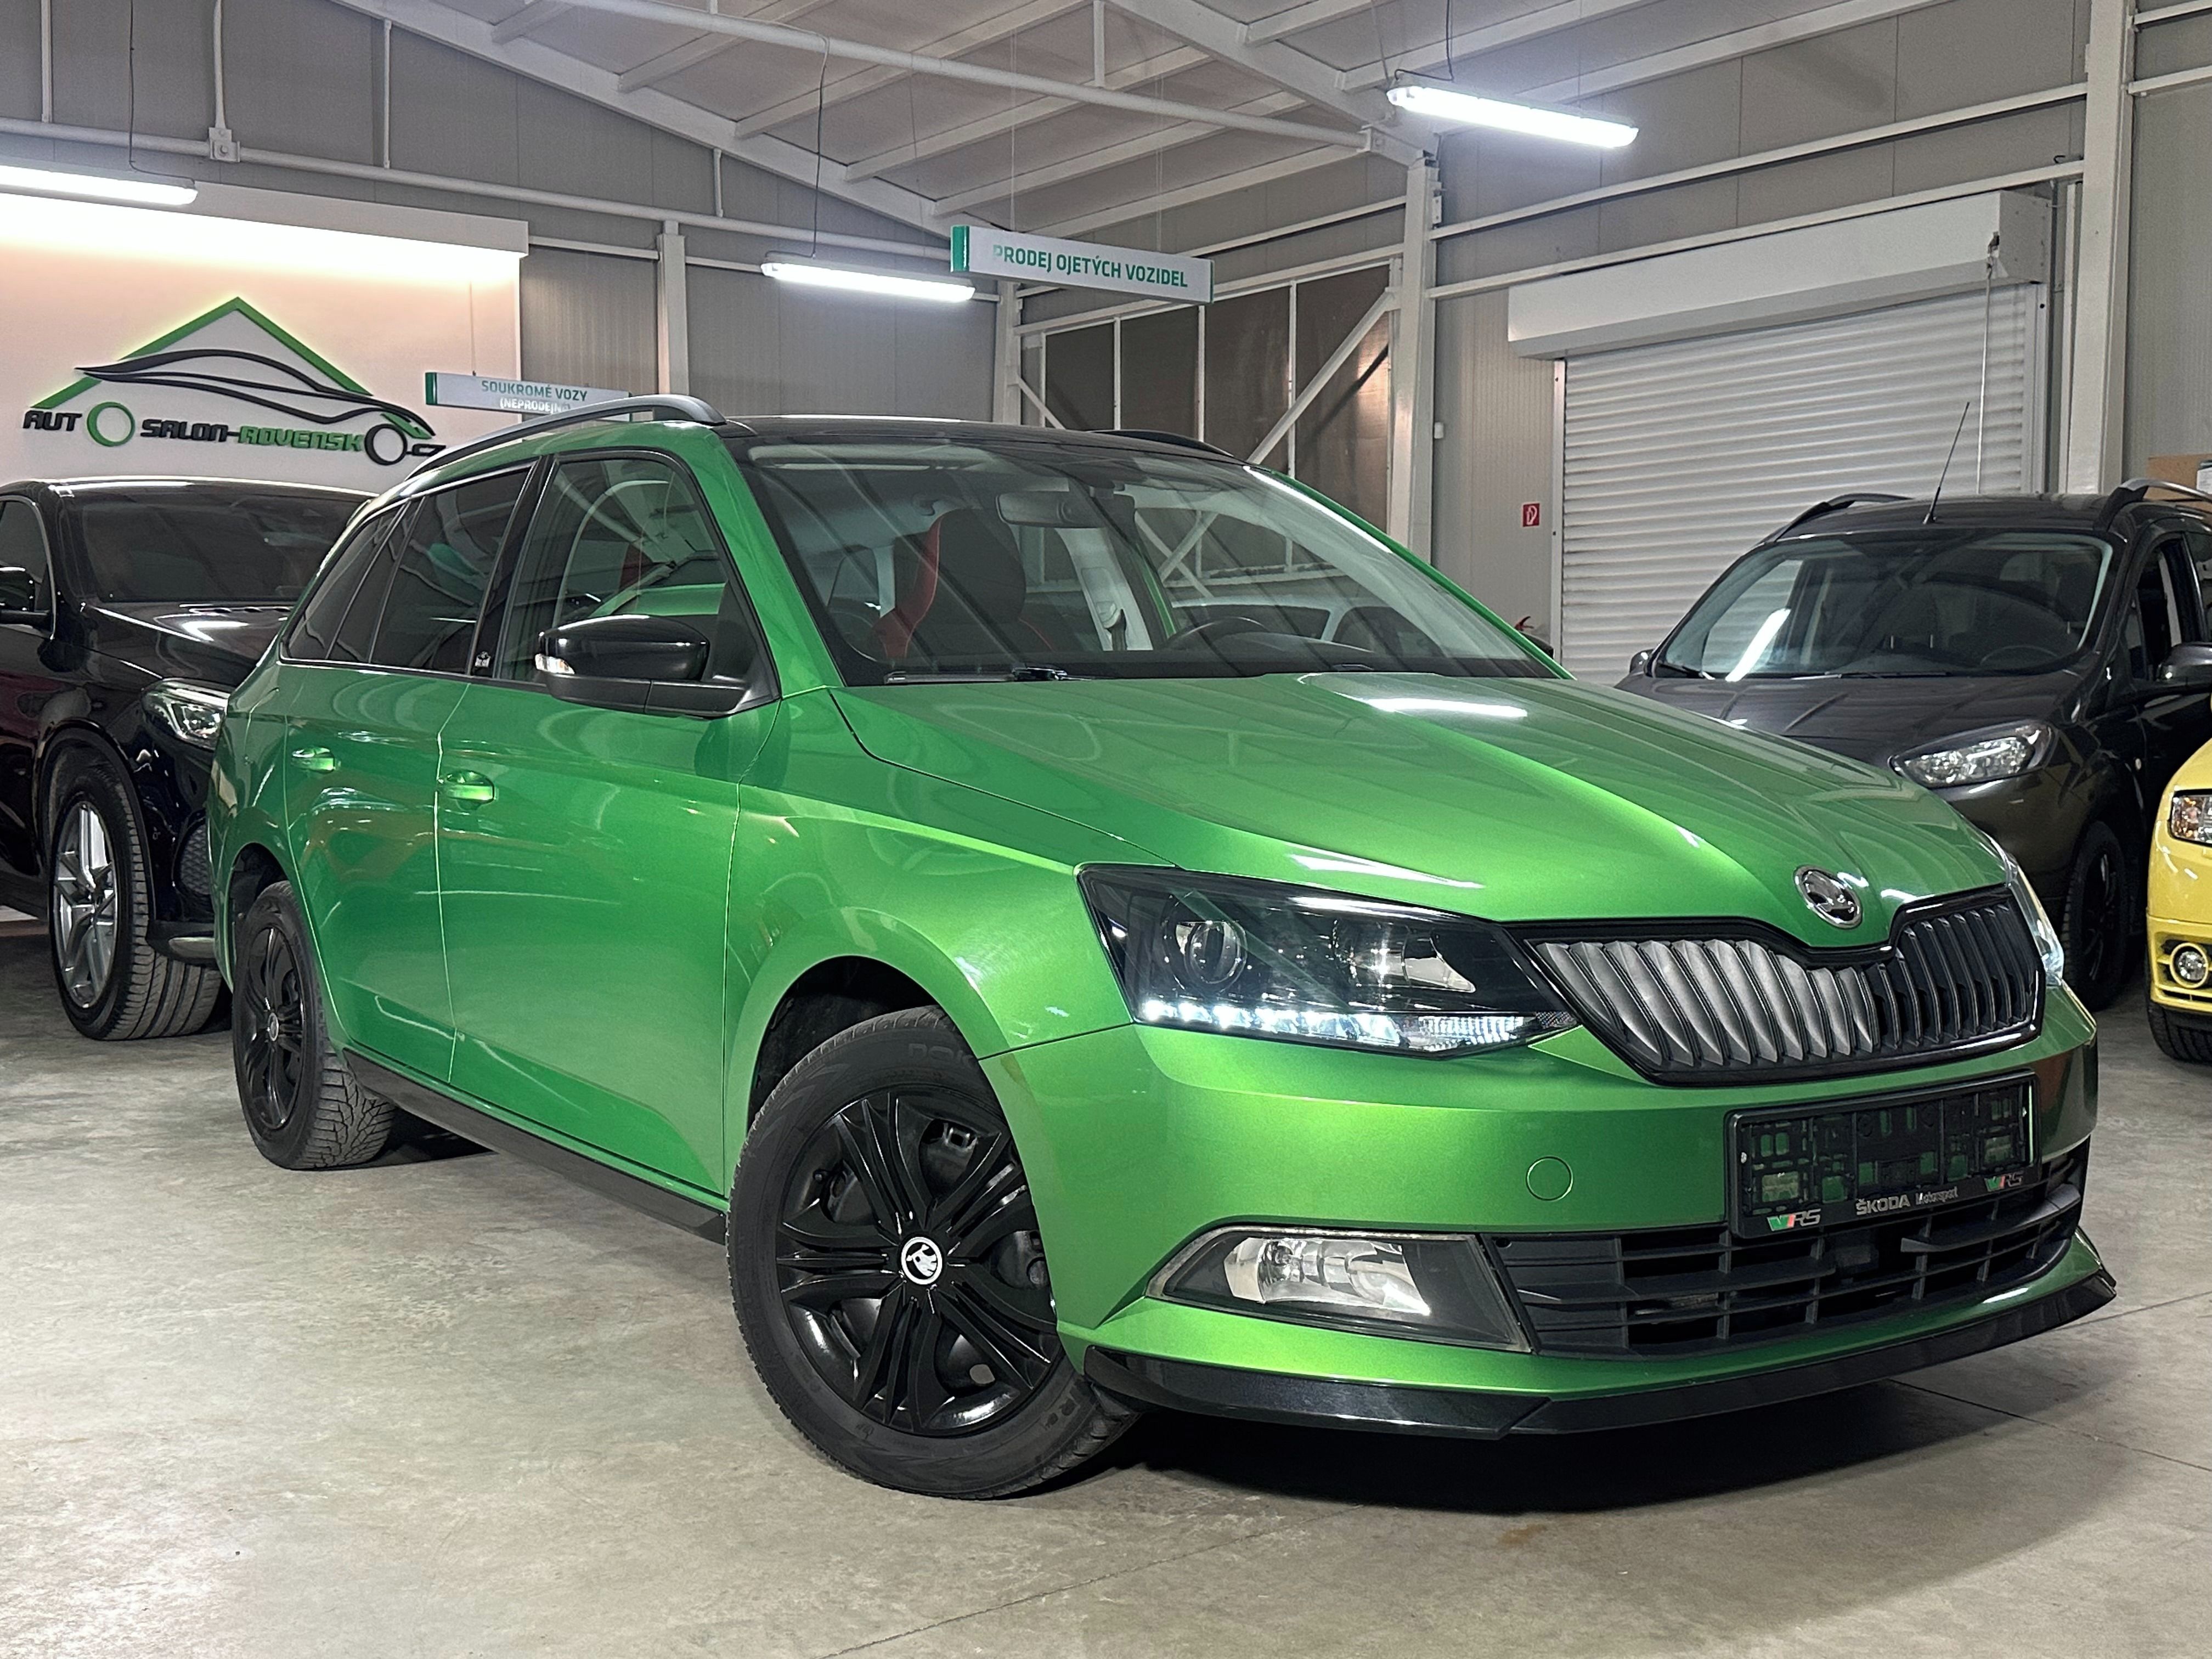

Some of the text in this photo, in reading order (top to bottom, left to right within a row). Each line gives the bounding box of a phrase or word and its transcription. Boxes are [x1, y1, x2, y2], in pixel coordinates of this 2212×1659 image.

[993, 245, 1188, 287] PRODEJ OJETÝCH VOZIDEL
[482, 380, 588, 402] SOUKROMÉ VOZY
[1856, 1194, 1911, 1216] ŠKODA
